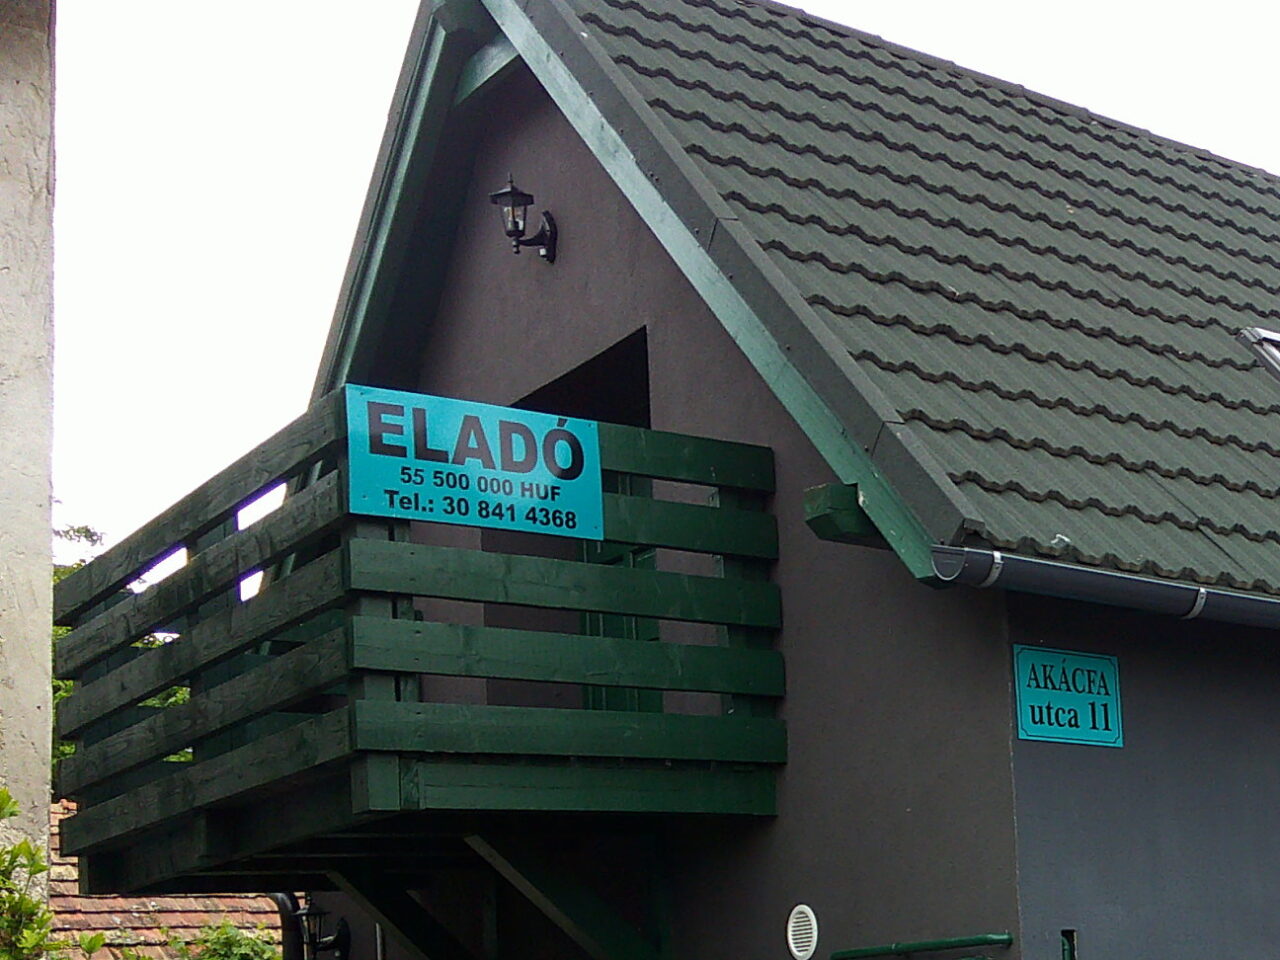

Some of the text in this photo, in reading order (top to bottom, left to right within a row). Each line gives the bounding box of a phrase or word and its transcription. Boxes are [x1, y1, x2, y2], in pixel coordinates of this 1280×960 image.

[367, 401, 584, 480] ELADÓ
[400, 467, 561, 501] 55 500 000 HUF
[384, 490, 577, 529] Tel.: 30 841 4368
[1027, 658, 1111, 696] AKÁCFA
[1029, 701, 1112, 731] utca 11
